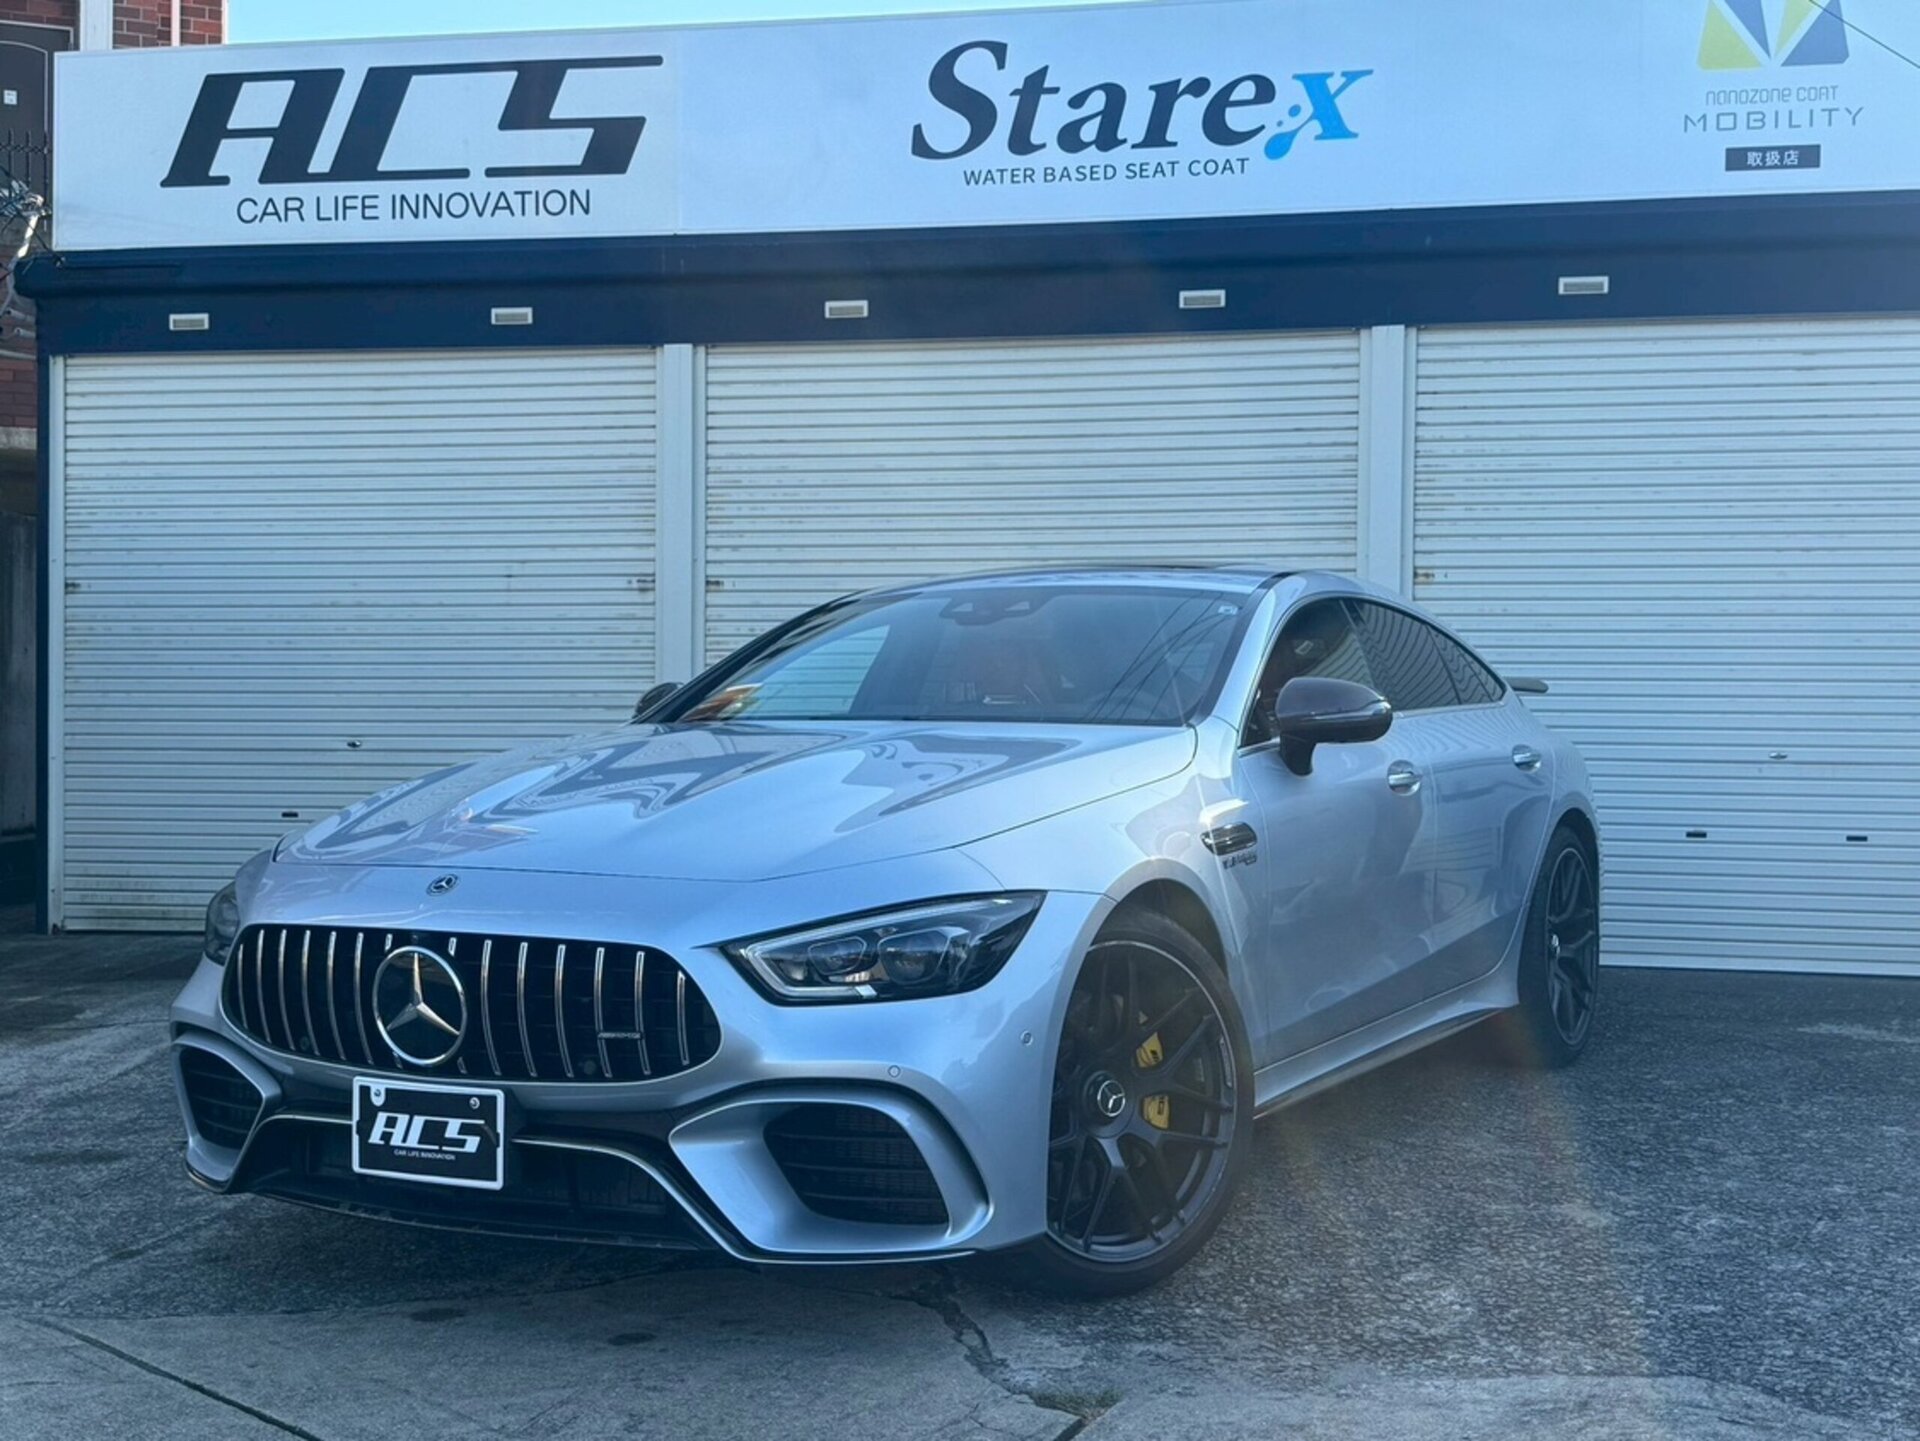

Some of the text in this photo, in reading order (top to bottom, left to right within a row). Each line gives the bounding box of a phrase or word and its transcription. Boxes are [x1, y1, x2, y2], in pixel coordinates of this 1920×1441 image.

[911, 39, 1375, 161] Starex
[1796, 85, 1839, 102] COAT
[159, 55, 664, 188] ACS
[1683, 106, 1864, 133] MOBILITY
[963, 157, 1250, 186] WATER BASED SEAT COAT
[1746, 150, 1799, 167] 取扱店
[236, 188, 592, 225] CAR LIFE INNOVATION
[368, 1111, 485, 1153] ACS
